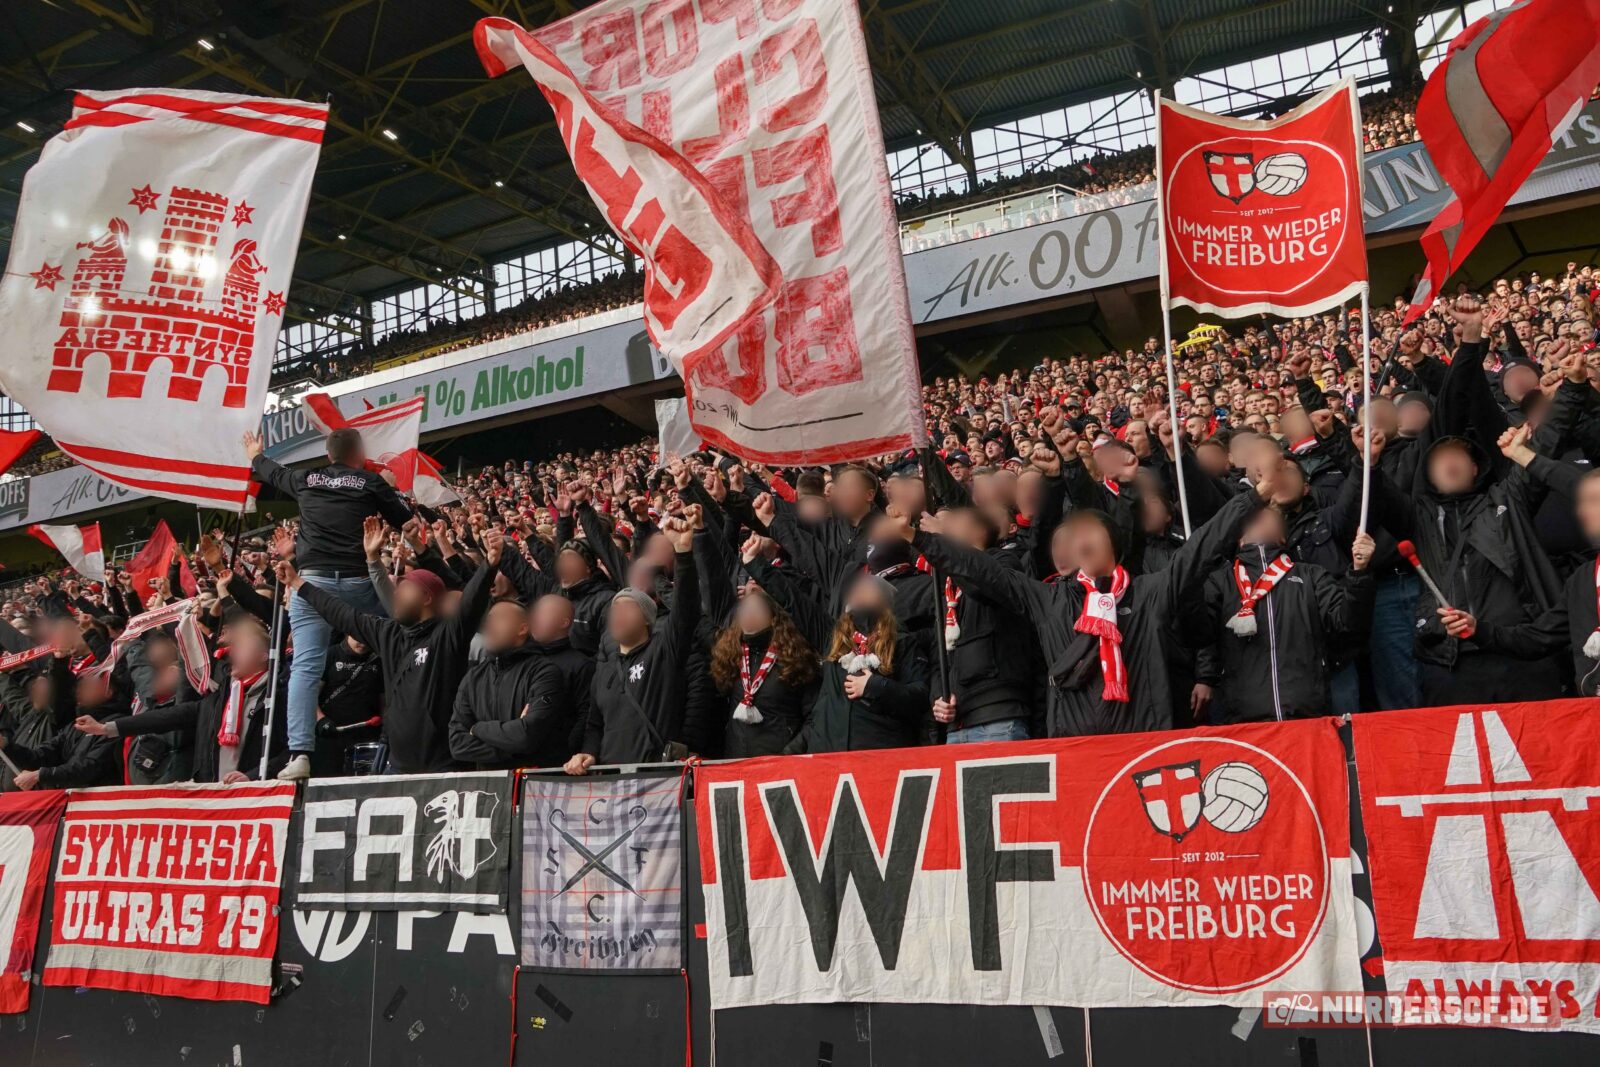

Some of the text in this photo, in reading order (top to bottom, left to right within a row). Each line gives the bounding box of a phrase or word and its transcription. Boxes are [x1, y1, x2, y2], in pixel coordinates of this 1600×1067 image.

[1257, 207, 1274, 216] 2012
[1262, 207, 1341, 241] WIEDER
[1192, 233, 1328, 266] FREIBURG
[923, 251, 1020, 321] Alk.
[470, 345, 585, 412] Alkohol
[61, 822, 277, 882] SYNTHESIA
[710, 757, 1057, 977] IWF
[1182, 852, 1225, 863] SEIT 2012
[1213, 874, 1314, 901] WIEDER
[62, 889, 206, 947] ULTRAS
[217, 894, 267, 949] 79
[1126, 904, 1296, 940] FREIBURG
[1404, 978, 1581, 1019] ALWAYS
